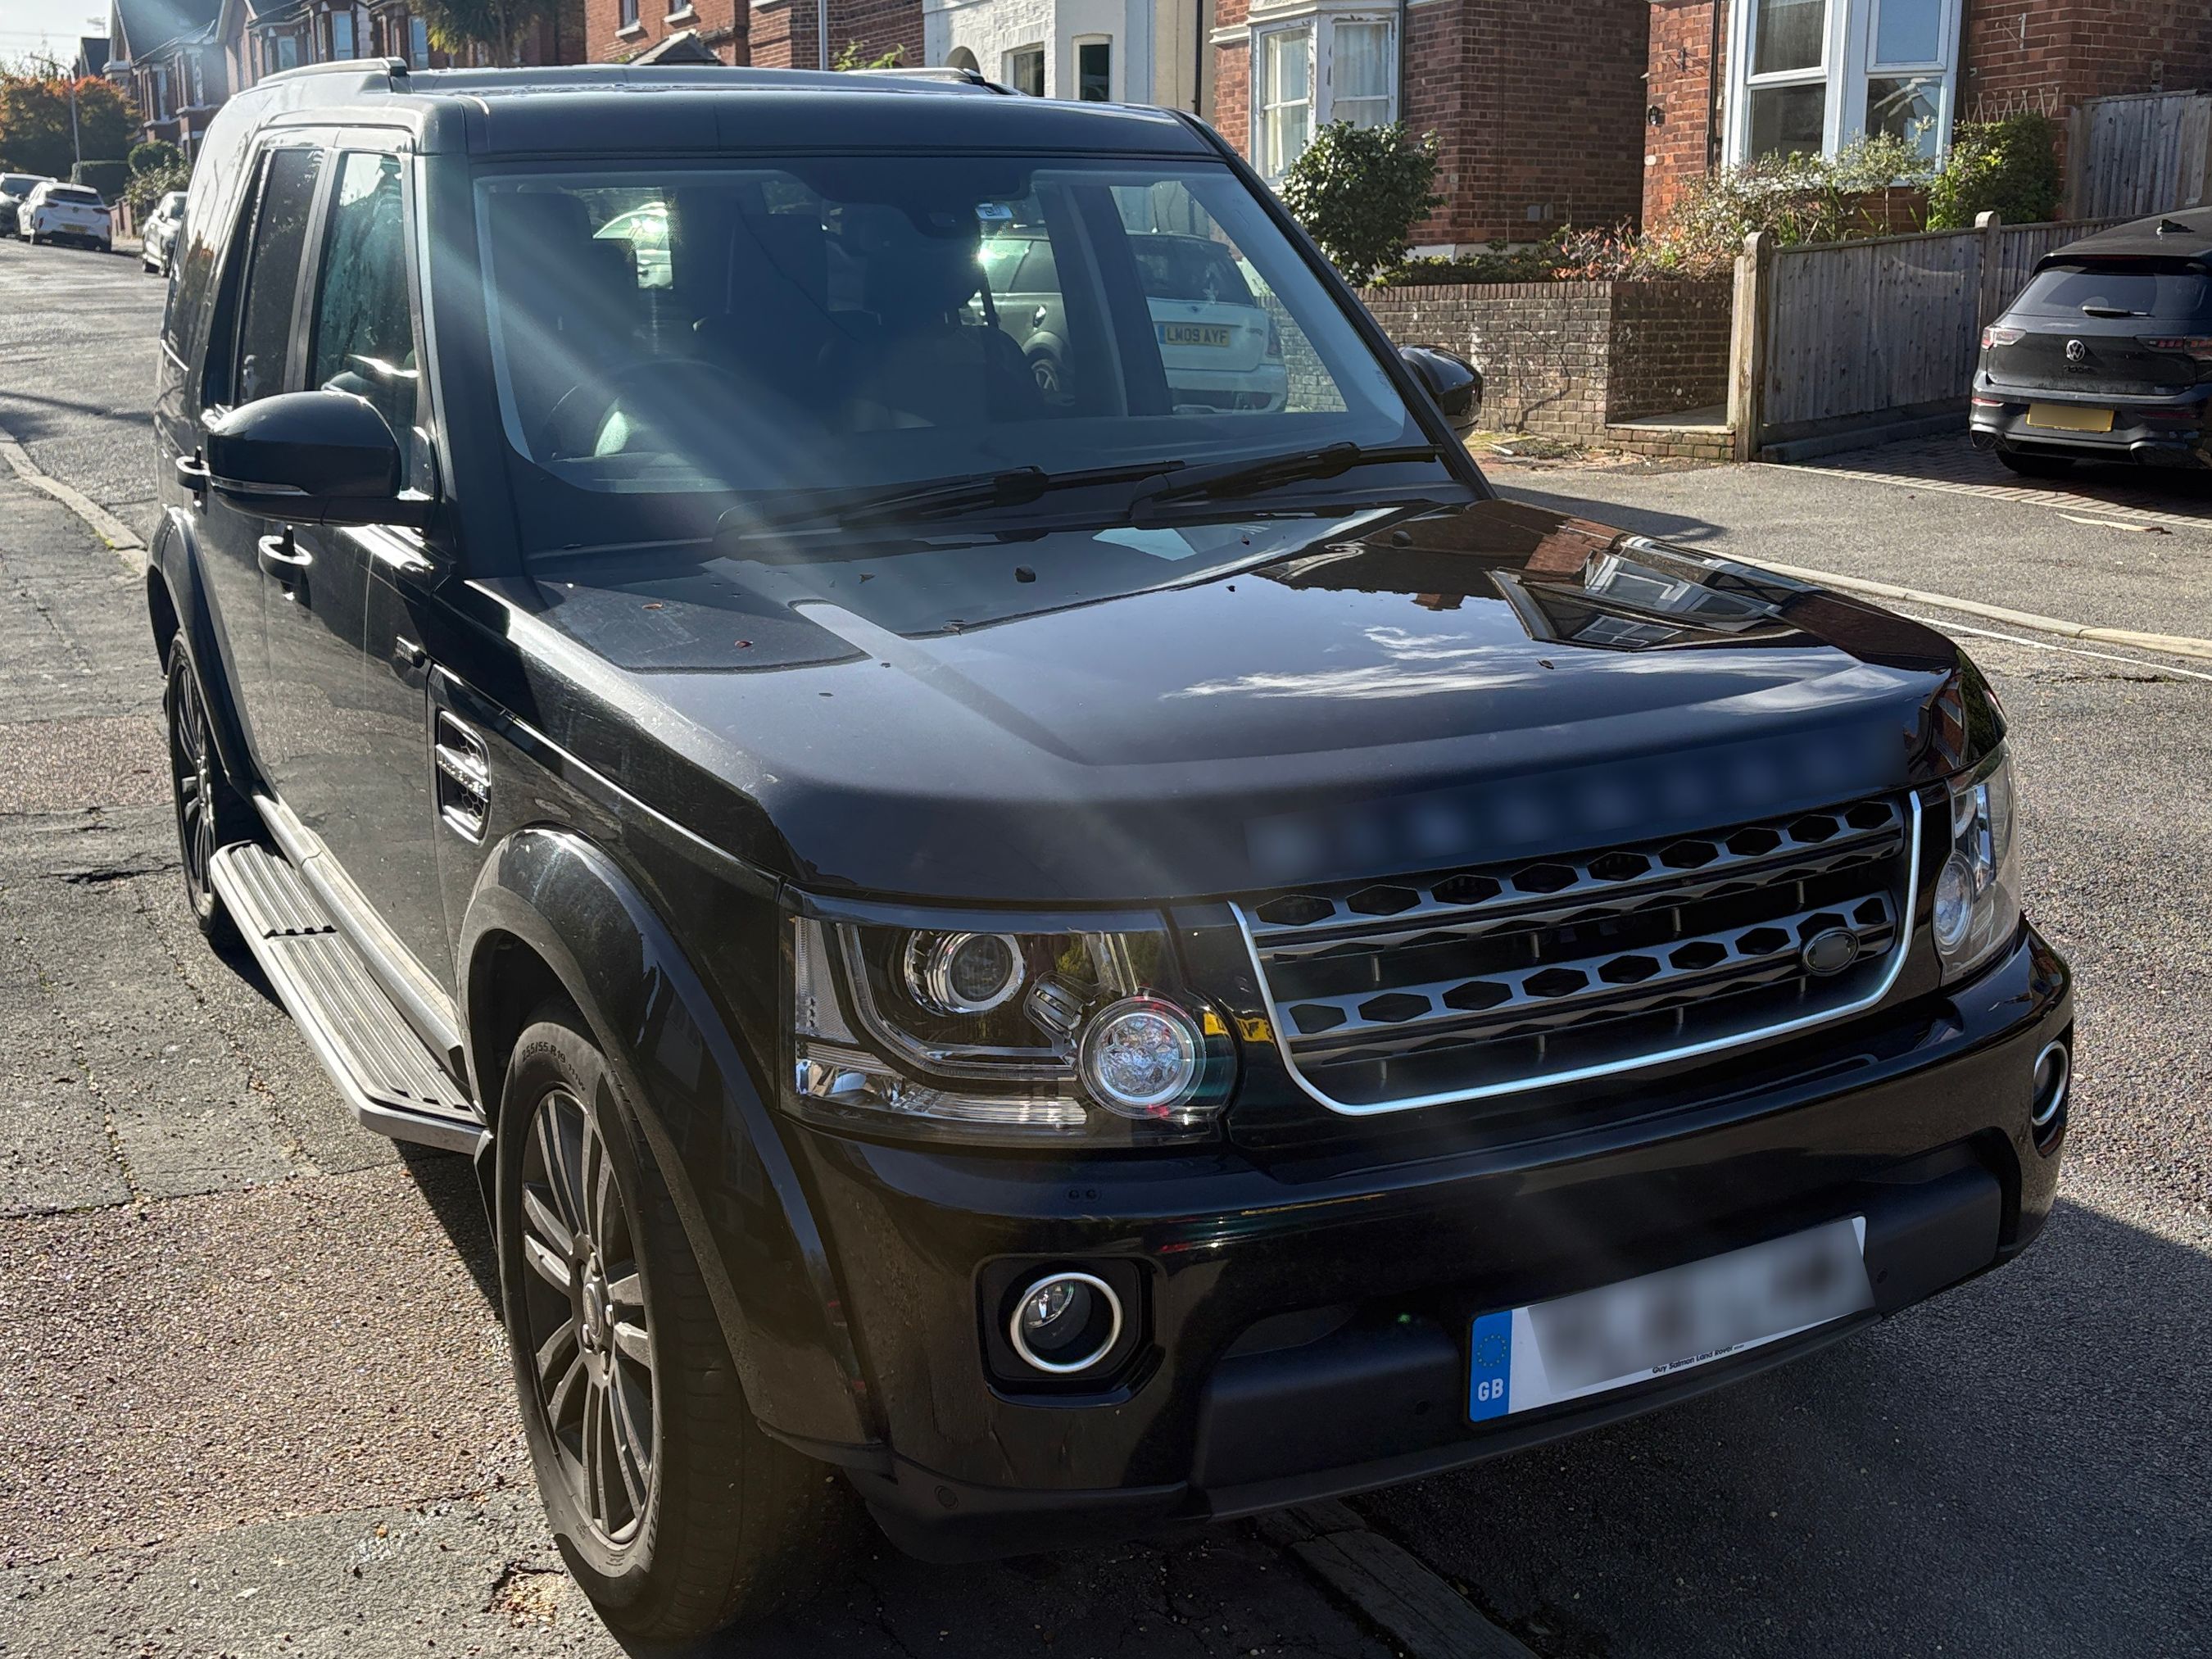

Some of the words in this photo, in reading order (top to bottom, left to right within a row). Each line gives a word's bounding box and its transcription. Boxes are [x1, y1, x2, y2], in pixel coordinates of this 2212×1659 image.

[1204, 329, 1228, 343] AYF
[521, 1041, 548, 1063] 255/55
[1652, 1364, 1667, 1374] Guy
[1696, 1351, 1713, 1362] Land
[1715, 1346, 1734, 1357] Rover
[1478, 1378, 1503, 1402] GB
